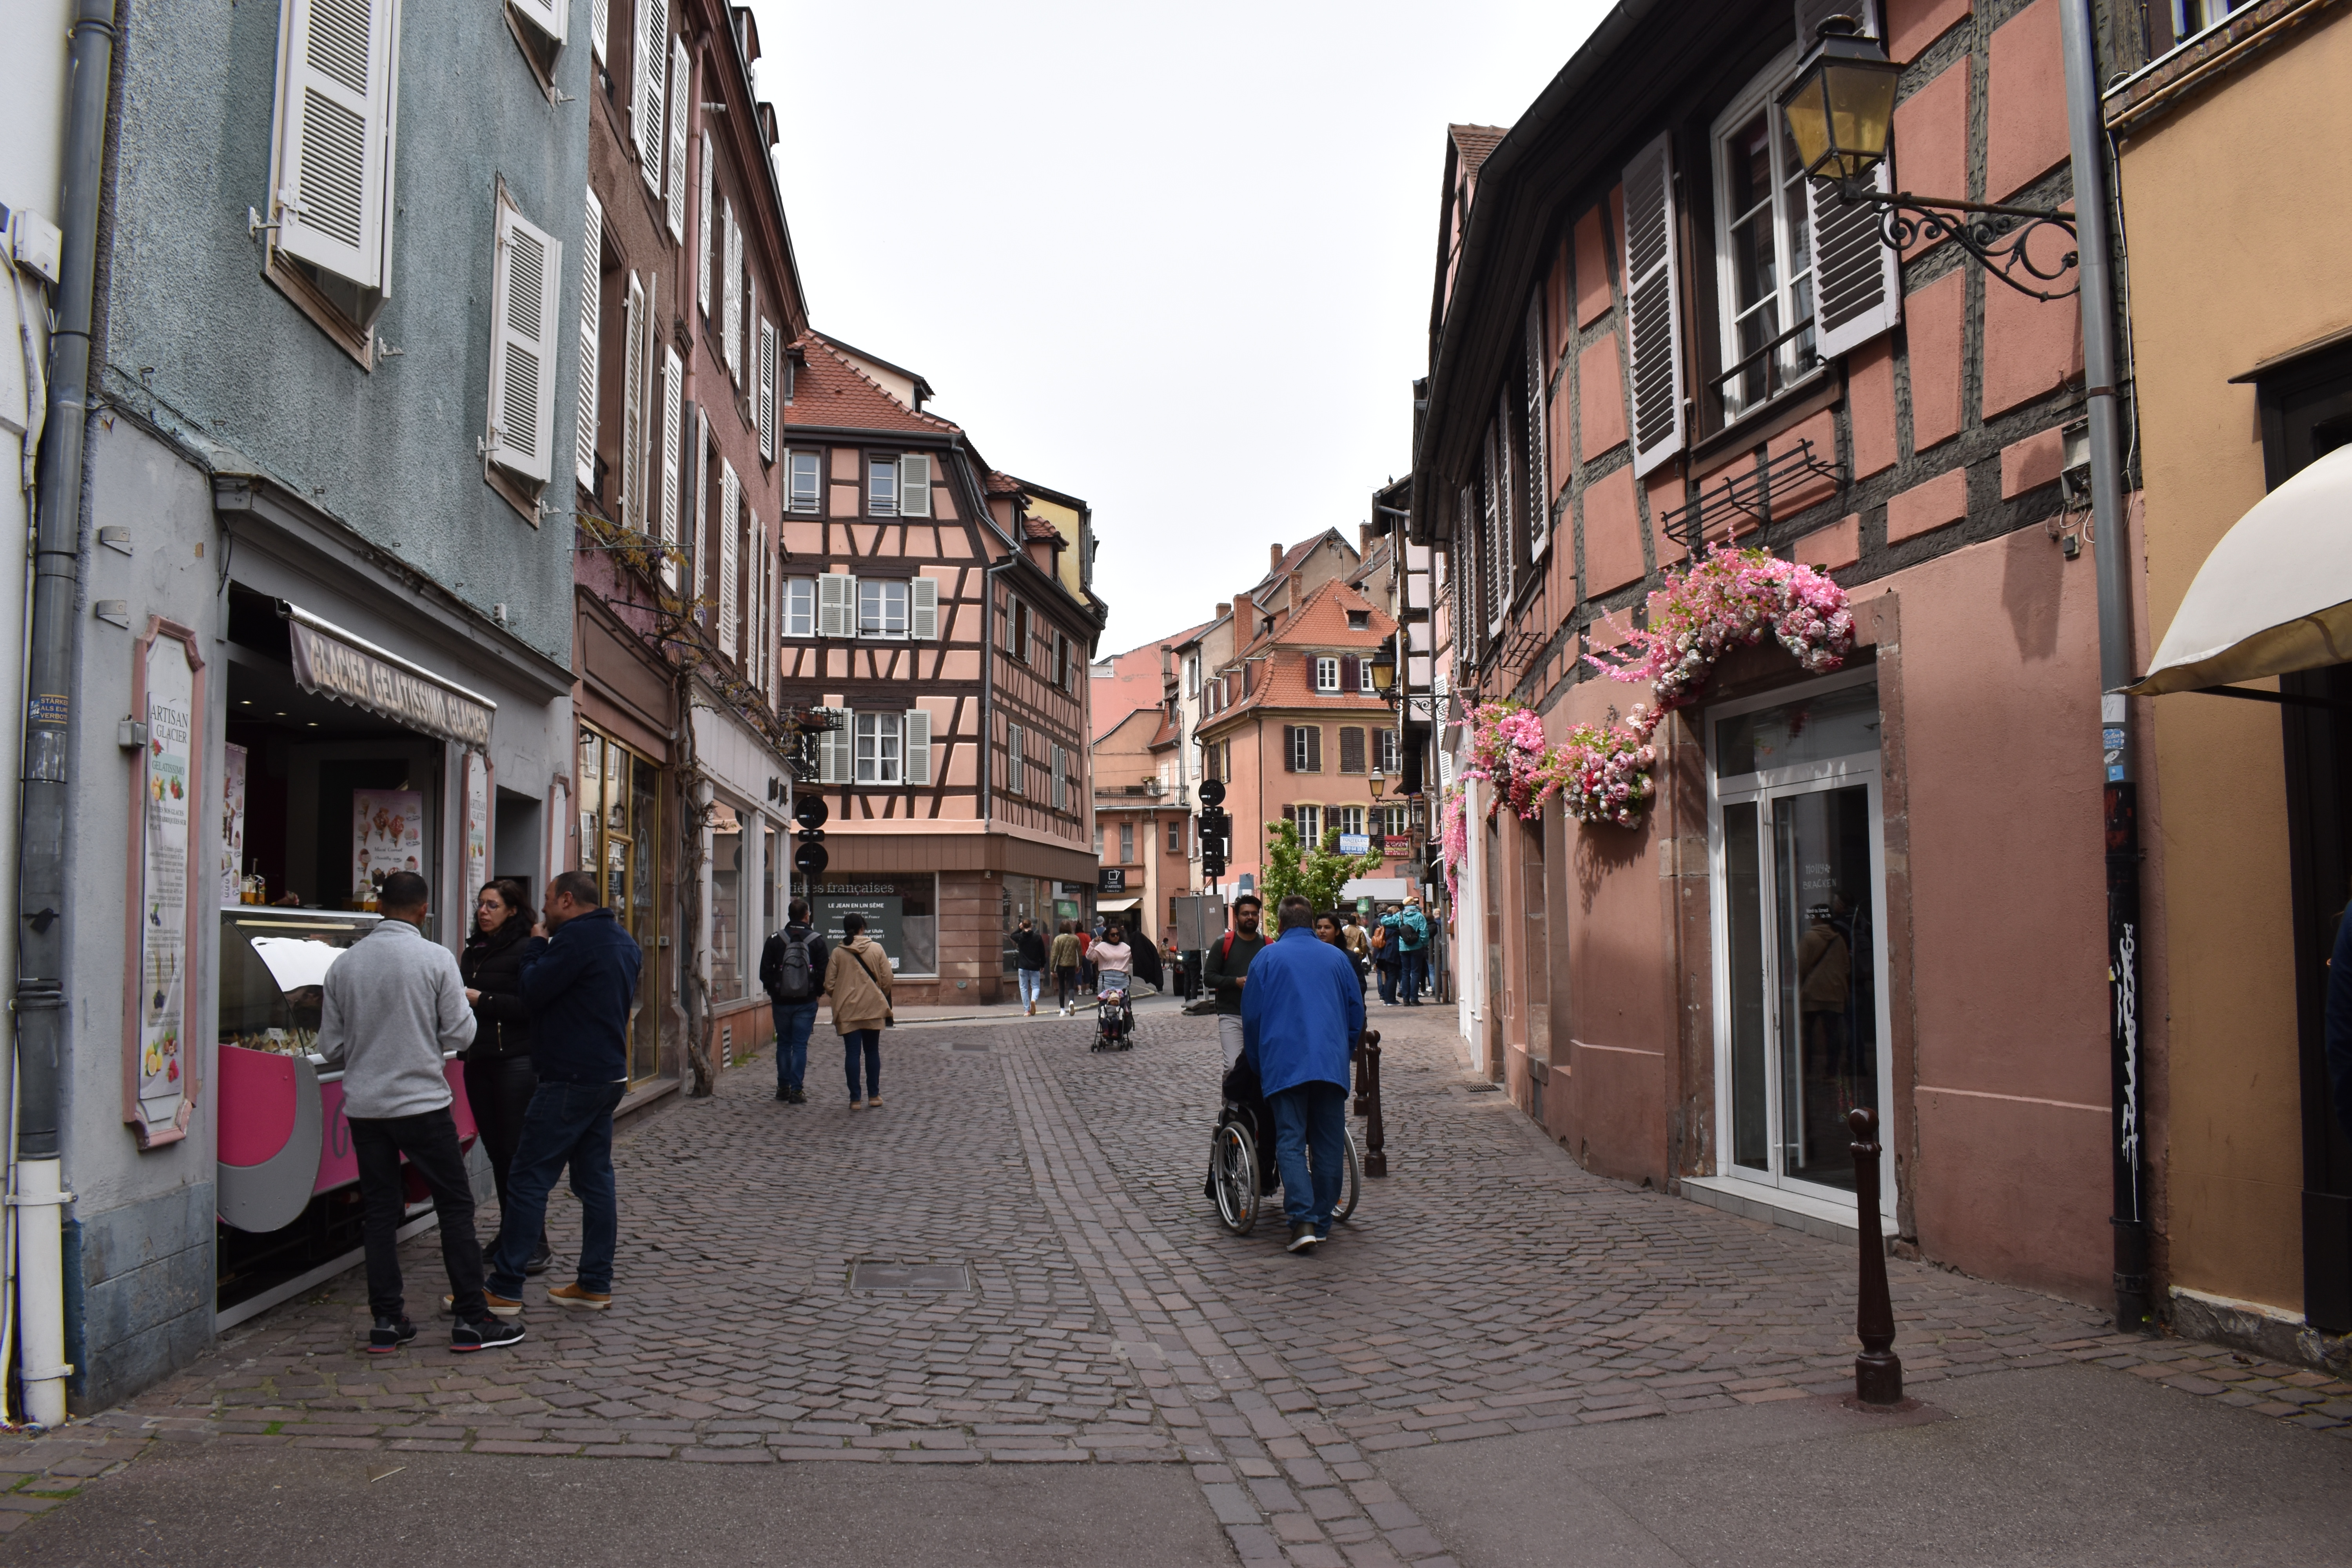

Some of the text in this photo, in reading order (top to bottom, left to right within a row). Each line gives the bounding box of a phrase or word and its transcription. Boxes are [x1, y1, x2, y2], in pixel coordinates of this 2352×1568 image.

[310, 634, 488, 743] GLACIER GELATISSIMO GLACIER
[151, 704, 188, 728] ARTISAN
[156, 724, 187, 744] GLACIER
[152, 760, 185, 775] GELATISSIMO
[826, 882, 894, 895] françaises
[1803, 878, 1836, 890] BRACKEN
